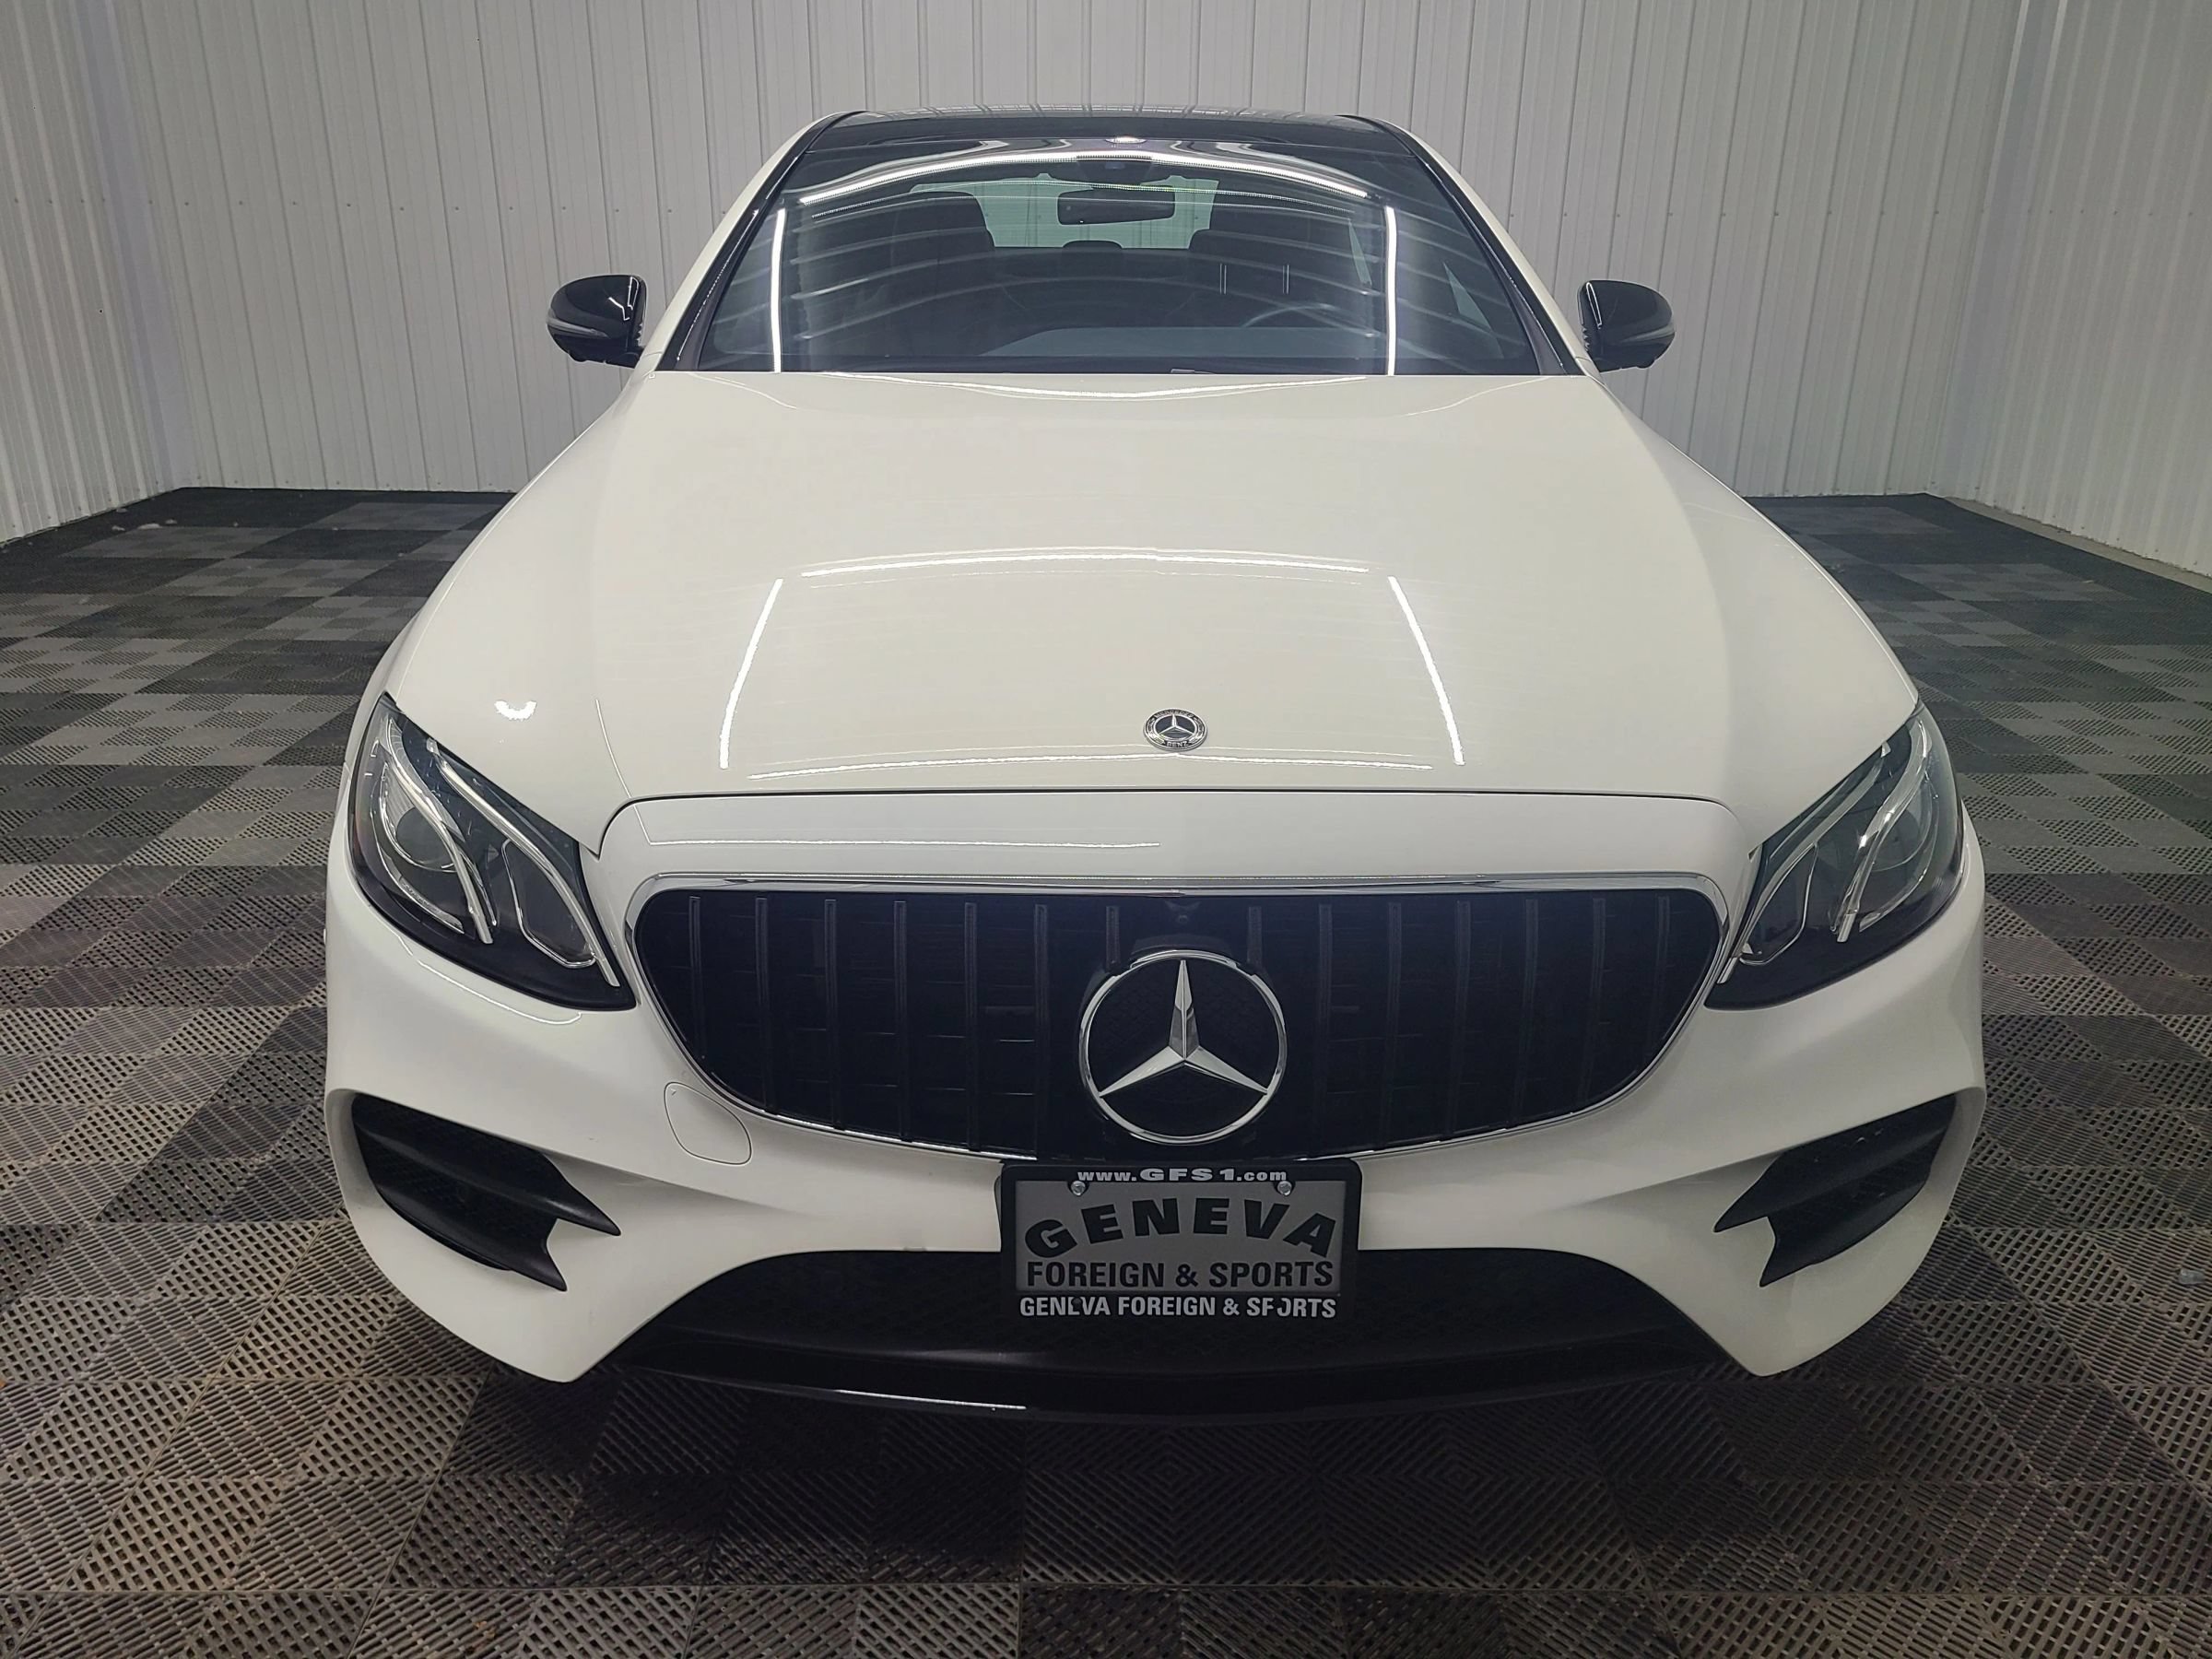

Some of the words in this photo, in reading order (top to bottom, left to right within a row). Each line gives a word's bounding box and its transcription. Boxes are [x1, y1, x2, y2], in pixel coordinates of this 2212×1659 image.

[1077, 1168, 1287, 1182] www.GFS1.com
[1025, 1198, 1336, 1259] GENEVA
[1028, 1262, 1165, 1288] FOREIGN
[1175, 1264, 1198, 1287] &
[1209, 1261, 1334, 1288] SPORTS
[1118, 1297, 1216, 1316] FOREIGN
[1222, 1298, 1240, 1316] &
